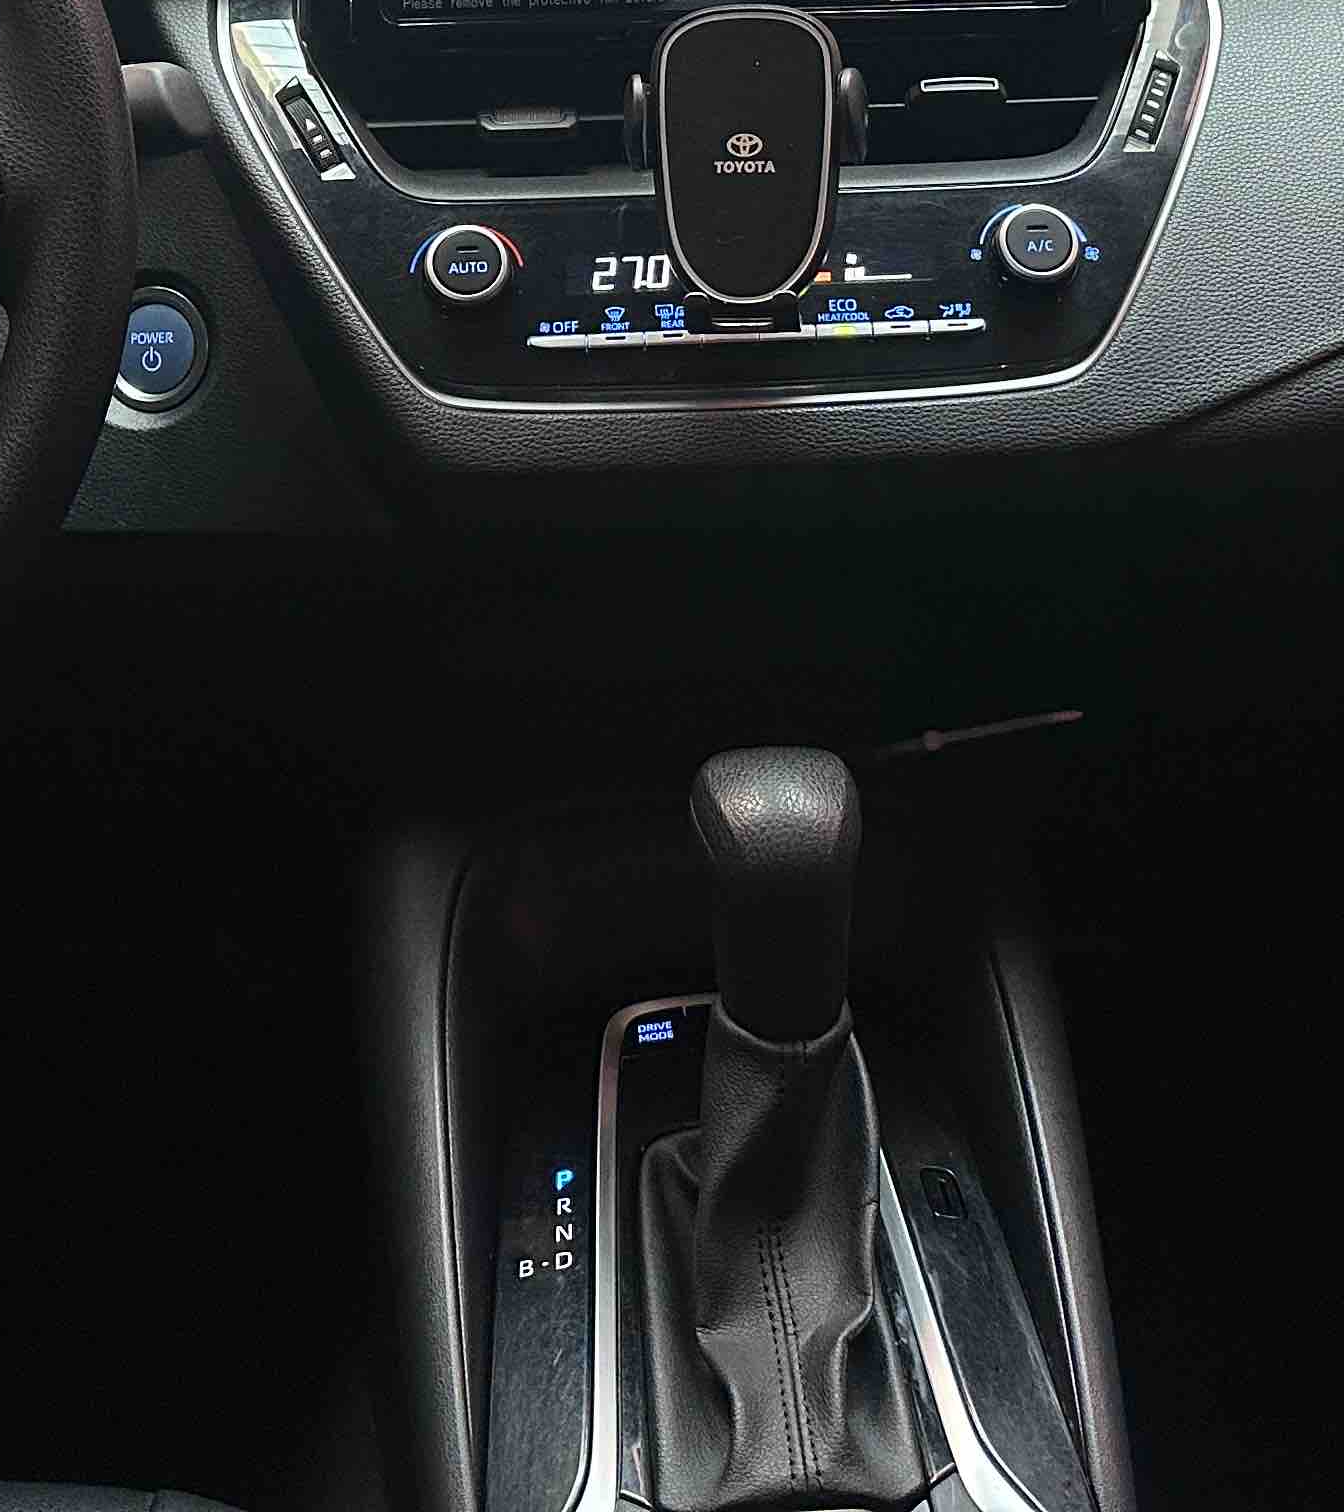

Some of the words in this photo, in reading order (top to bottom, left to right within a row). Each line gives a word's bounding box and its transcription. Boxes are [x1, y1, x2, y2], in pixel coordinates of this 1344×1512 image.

[714, 160, 776, 174] TOYOTA
[1027, 240, 1054, 253] A/C
[448, 260, 488, 275] AUTO
[828, 298, 857, 311] ECO
[817, 311, 870, 322] HEAT/COOL
[552, 320, 579, 333] OFF
[601, 322, 630, 331] FRONT
[660, 319, 684, 328] REAR
[130, 331, 174, 345] POWER
[638, 1020, 672, 1033] DRIVE
[638, 1030, 674, 1044] MODE
[556, 1169, 574, 1191] P
[556, 1197, 572, 1215] R
[555, 1224, 573, 1243] N
